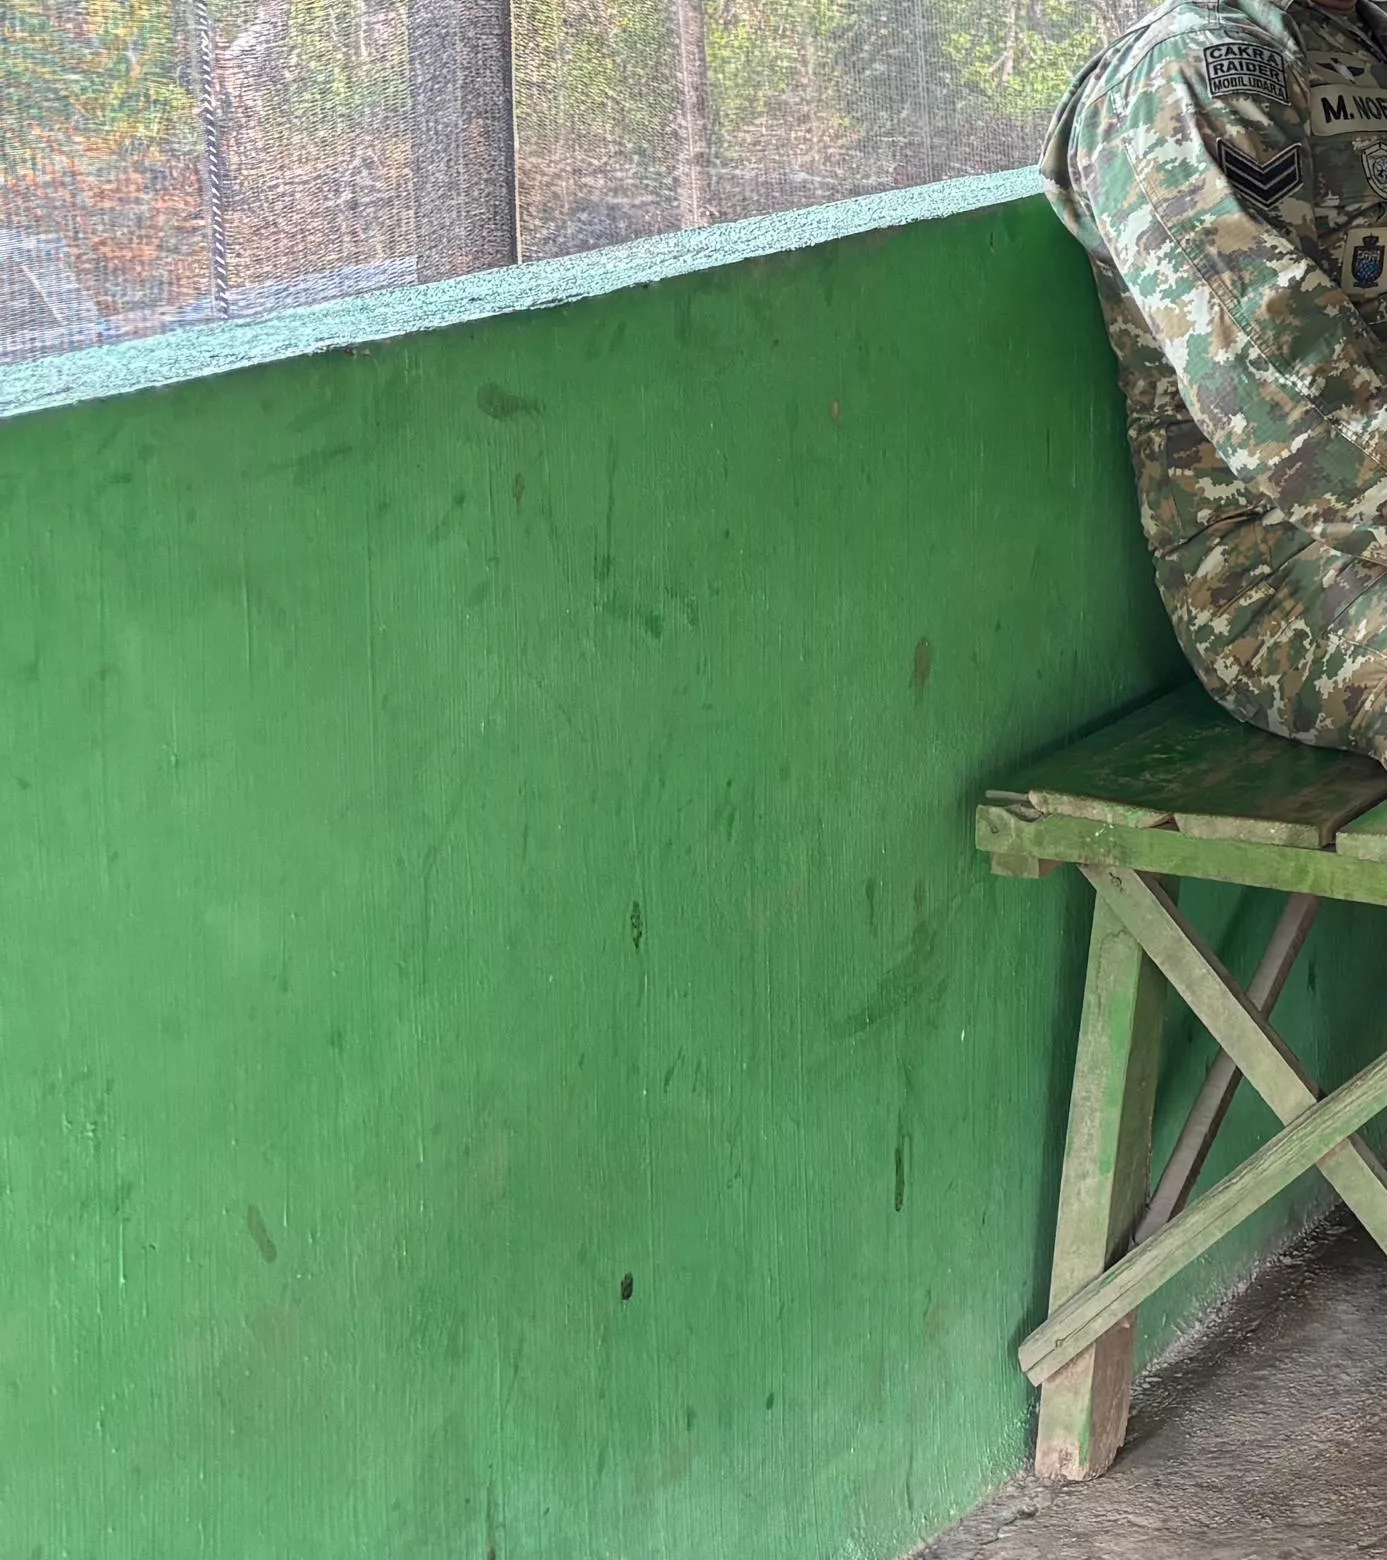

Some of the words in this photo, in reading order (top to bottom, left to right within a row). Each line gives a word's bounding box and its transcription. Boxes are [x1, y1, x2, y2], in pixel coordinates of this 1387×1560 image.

[1209, 45, 1280, 67] CAKRA
[1212, 60, 1281, 83] RAIDER
[1321, 94, 1354, 123] M.
